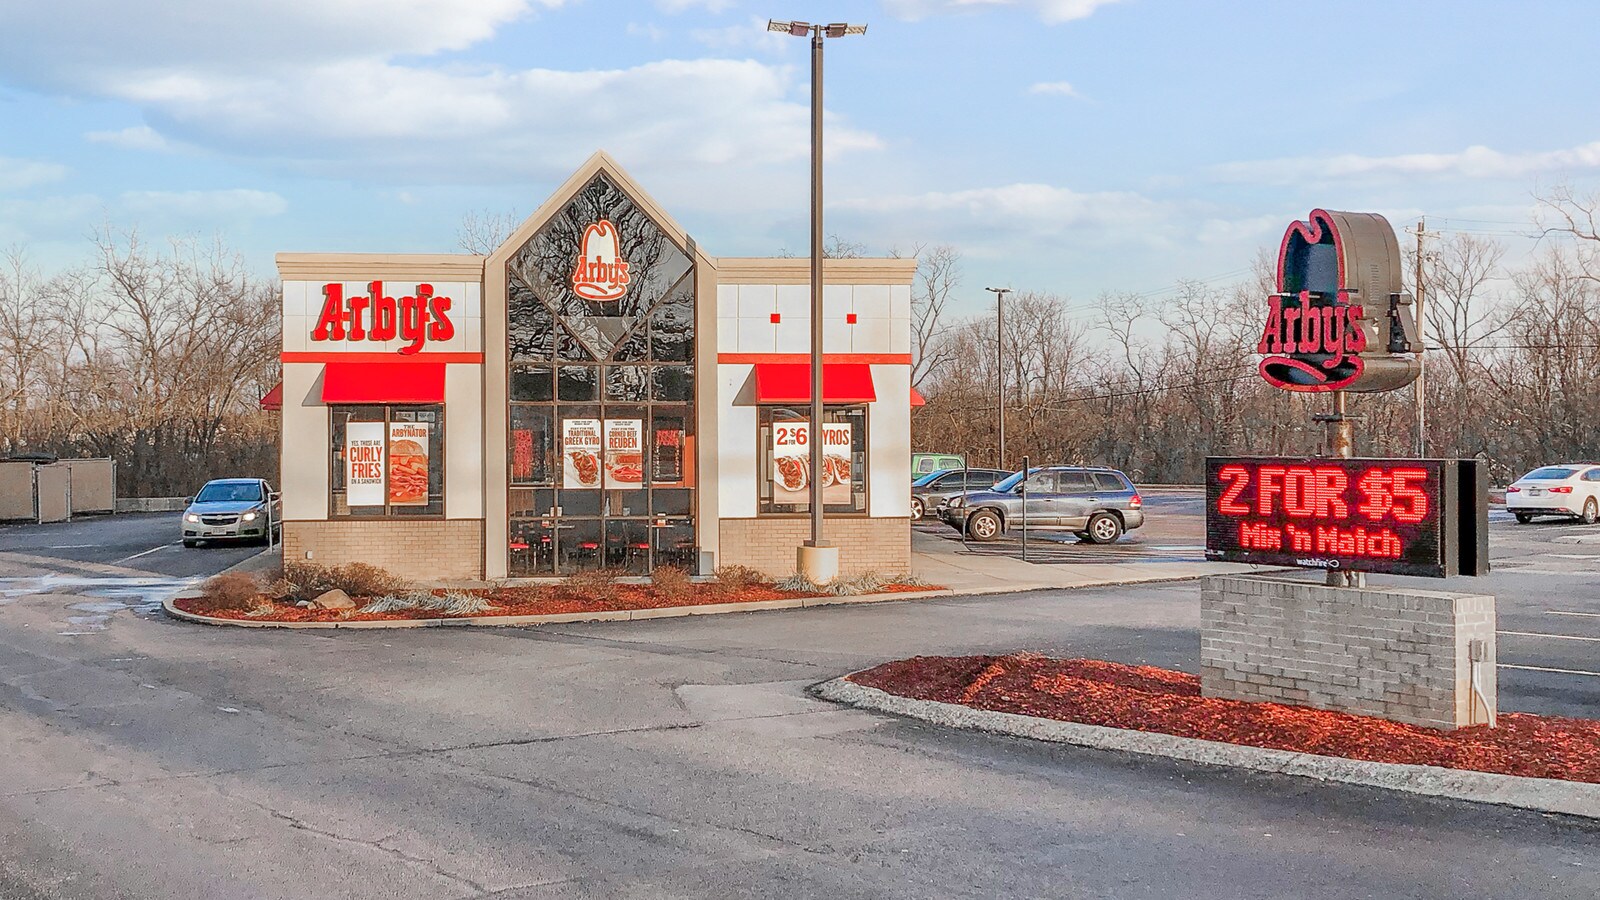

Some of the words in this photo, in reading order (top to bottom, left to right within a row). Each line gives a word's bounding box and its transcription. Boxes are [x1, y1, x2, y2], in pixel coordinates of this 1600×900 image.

[573, 255, 630, 289] Arby's
[310, 280, 455, 355] Arby's
[1257, 290, 1367, 369] Arby's
[391, 428, 427, 438] ARBYNATOR
[564, 436, 583, 445] GREEK
[584, 436, 600, 445] GYRO
[776, 427, 788, 445] 2
[821, 429, 849, 445] YROS
[609, 437, 637, 448] REUBEN
[350, 446, 383, 462] CURLY
[351, 462, 382, 478] FRIES
[1218, 464, 1250, 516] 2
[1257, 466, 1349, 520] FOR
[1357, 466, 1430, 524] $5
[1239, 521, 1283, 550] Mix
[1316, 525, 1403, 559] Match
